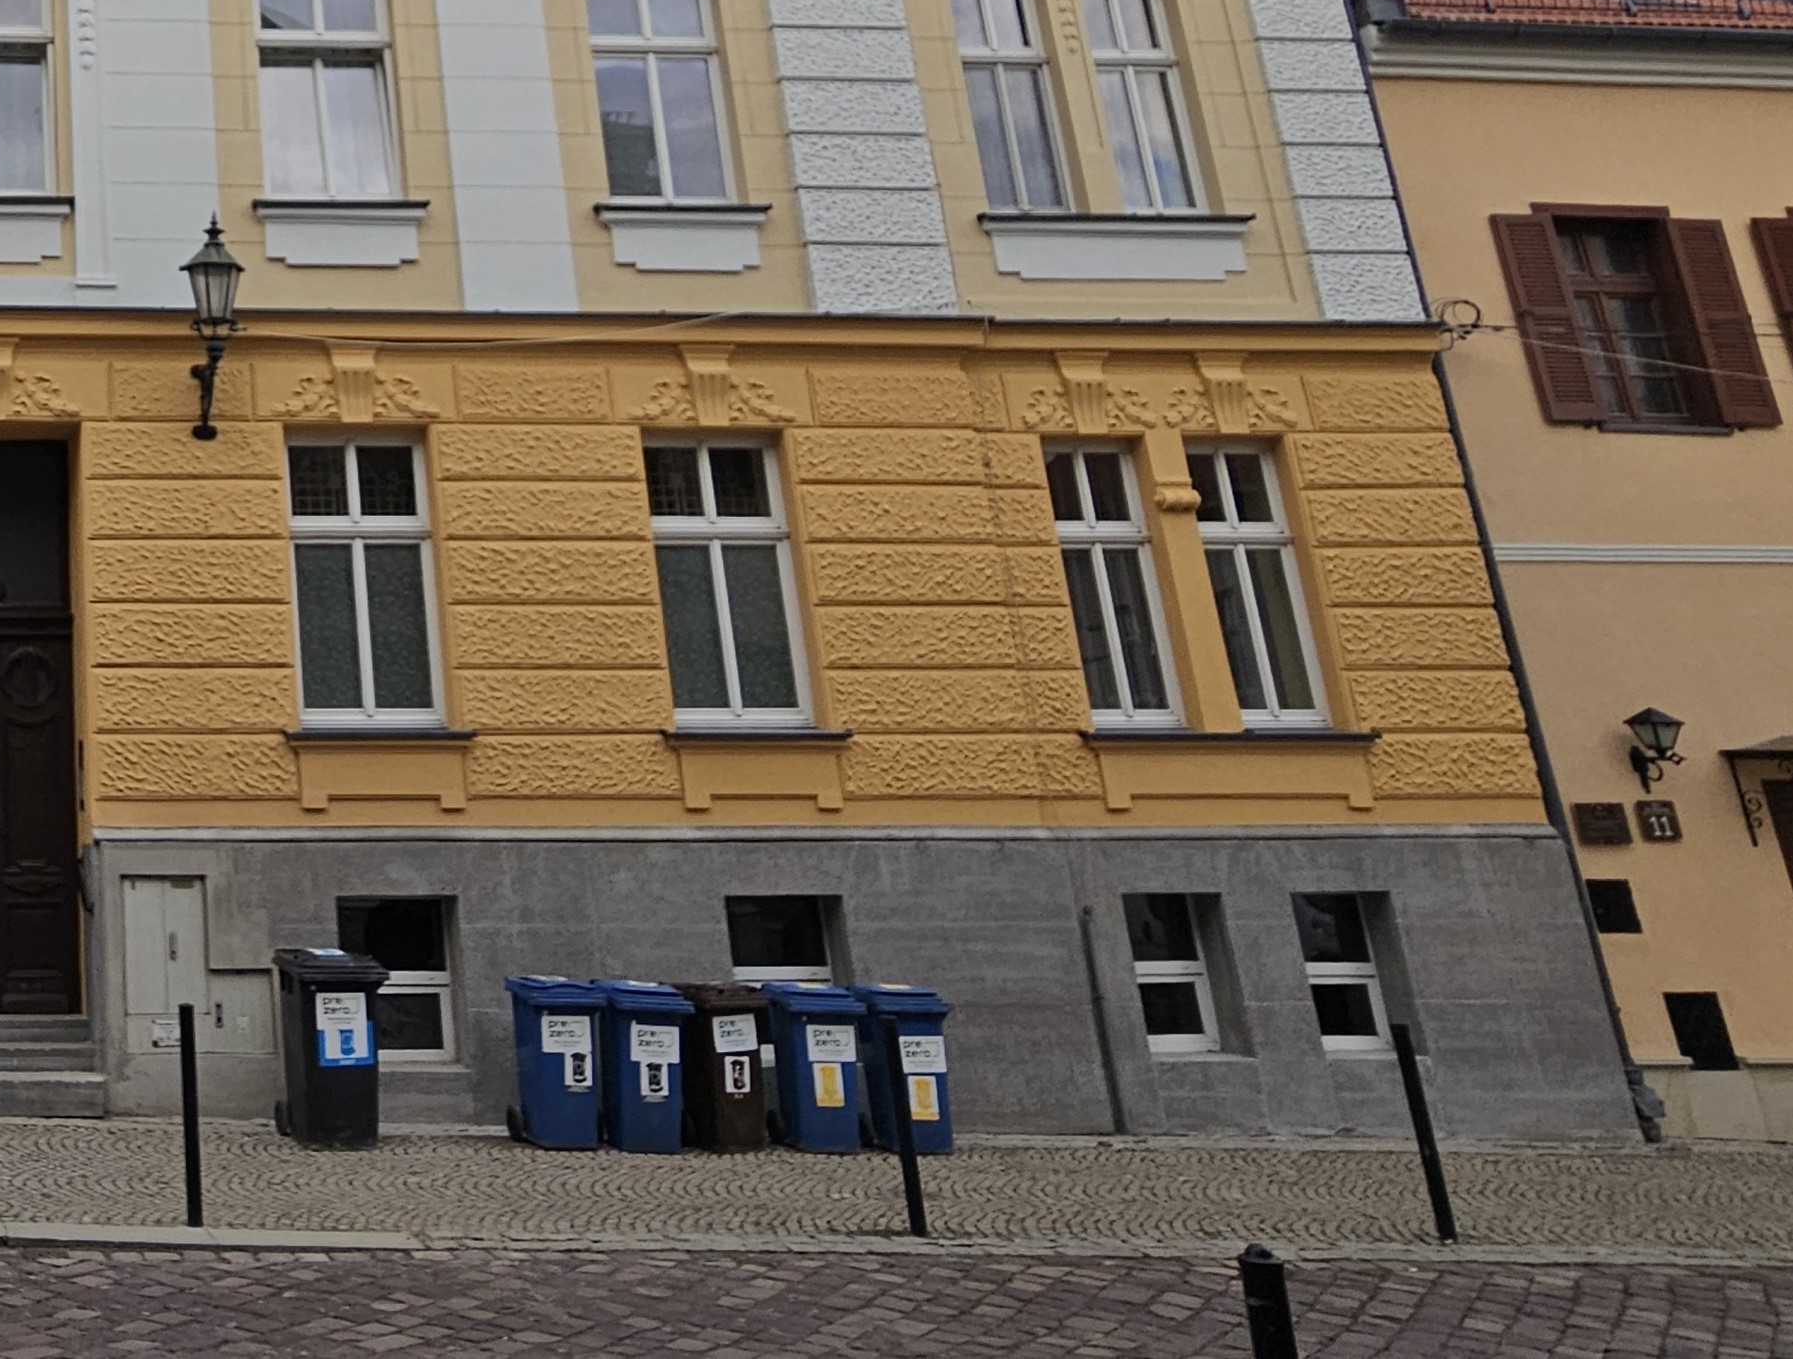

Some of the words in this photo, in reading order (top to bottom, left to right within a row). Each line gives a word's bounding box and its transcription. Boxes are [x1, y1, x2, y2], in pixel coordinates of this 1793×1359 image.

[1649, 816, 1674, 836] 11
[548, 1020, 568, 1028] pre
[548, 1030, 575, 1038] zero
[637, 1029, 658, 1038] pre
[812, 1029, 832, 1038] pre
[637, 1039, 664, 1047] zero
[902, 1040, 922, 1049] pre
[905, 1050, 931, 1058] zero
